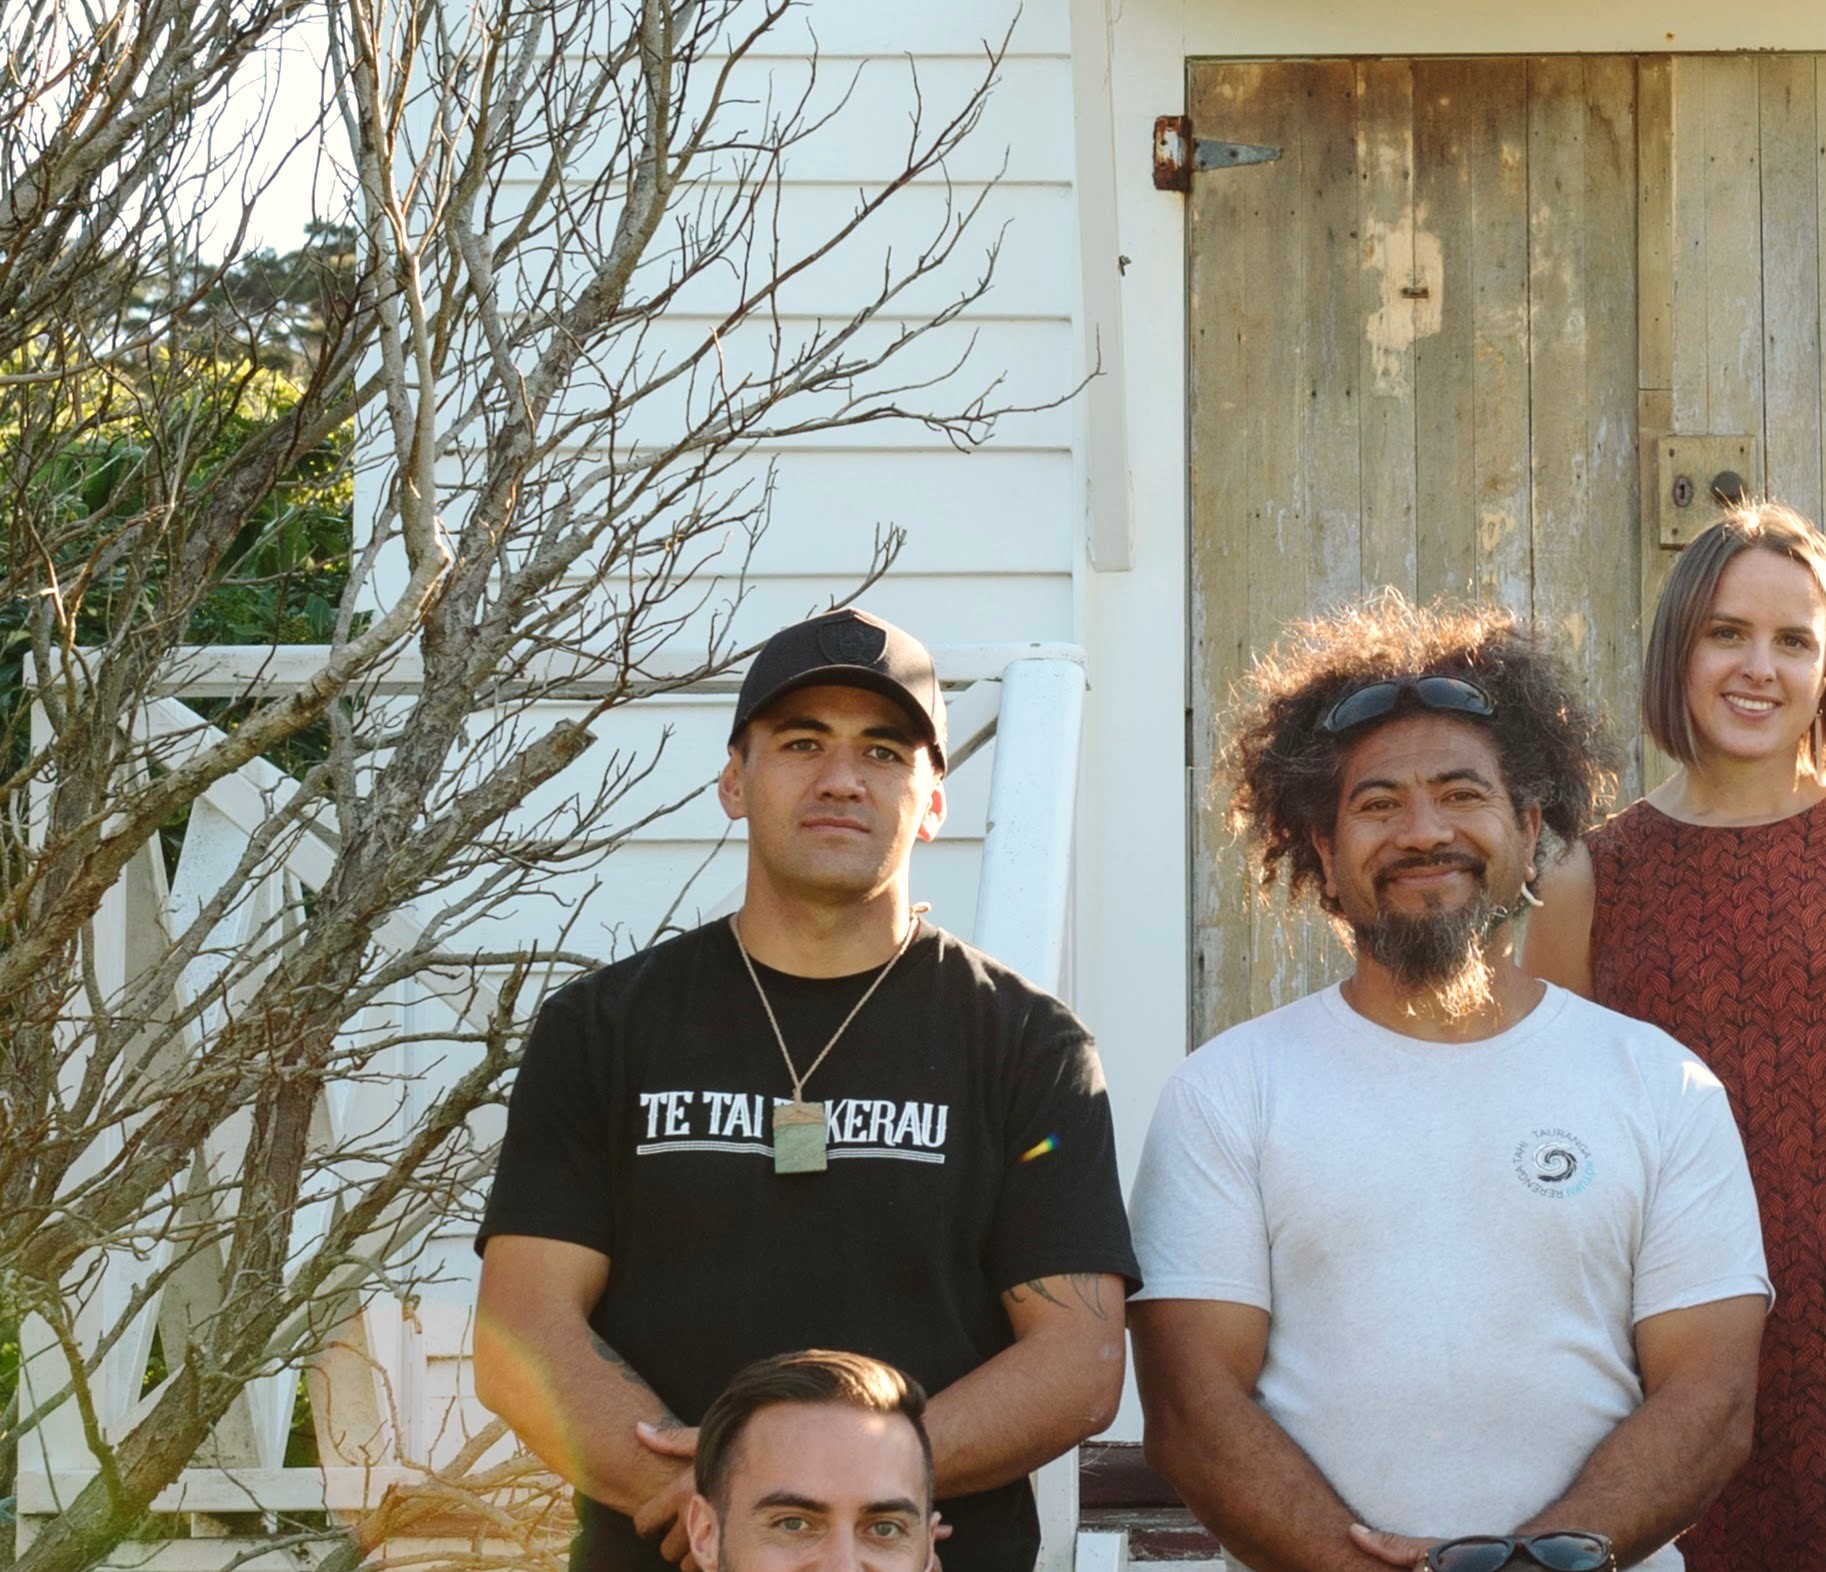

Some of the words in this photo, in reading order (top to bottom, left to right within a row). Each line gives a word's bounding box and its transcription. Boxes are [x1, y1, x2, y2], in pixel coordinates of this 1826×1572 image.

[640, 1091, 694, 1138] TE
[702, 1091, 764, 1139] TAI
[774, 1096, 949, 1148] KERAU
[1512, 1140, 1529, 1164] TAHI
[1531, 1128, 1592, 1159] TAURANGA
[1514, 1165, 1564, 1199] RERENGA
